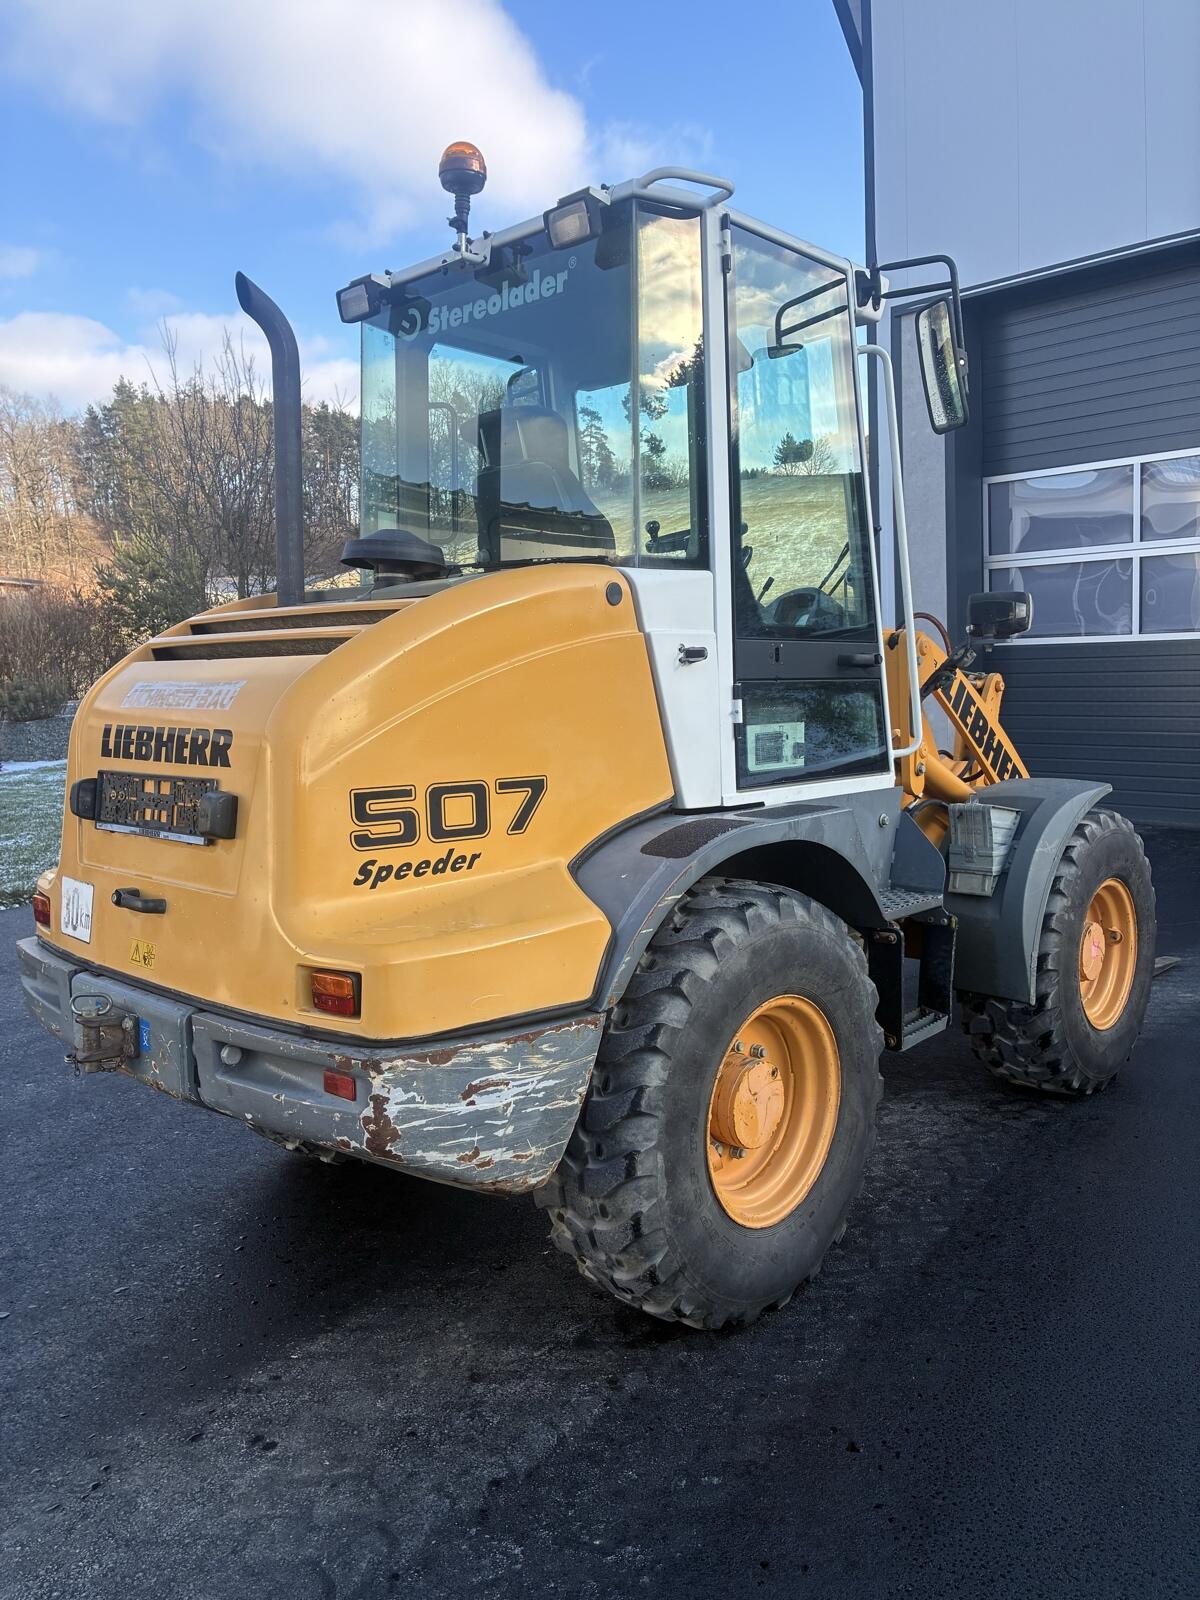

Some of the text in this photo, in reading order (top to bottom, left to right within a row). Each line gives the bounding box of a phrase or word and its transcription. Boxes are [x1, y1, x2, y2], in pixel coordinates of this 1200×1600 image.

[100, 723, 234, 768] LIEBHERR
[349, 774, 548, 852] 507
[352, 848, 482, 890] Speeder
